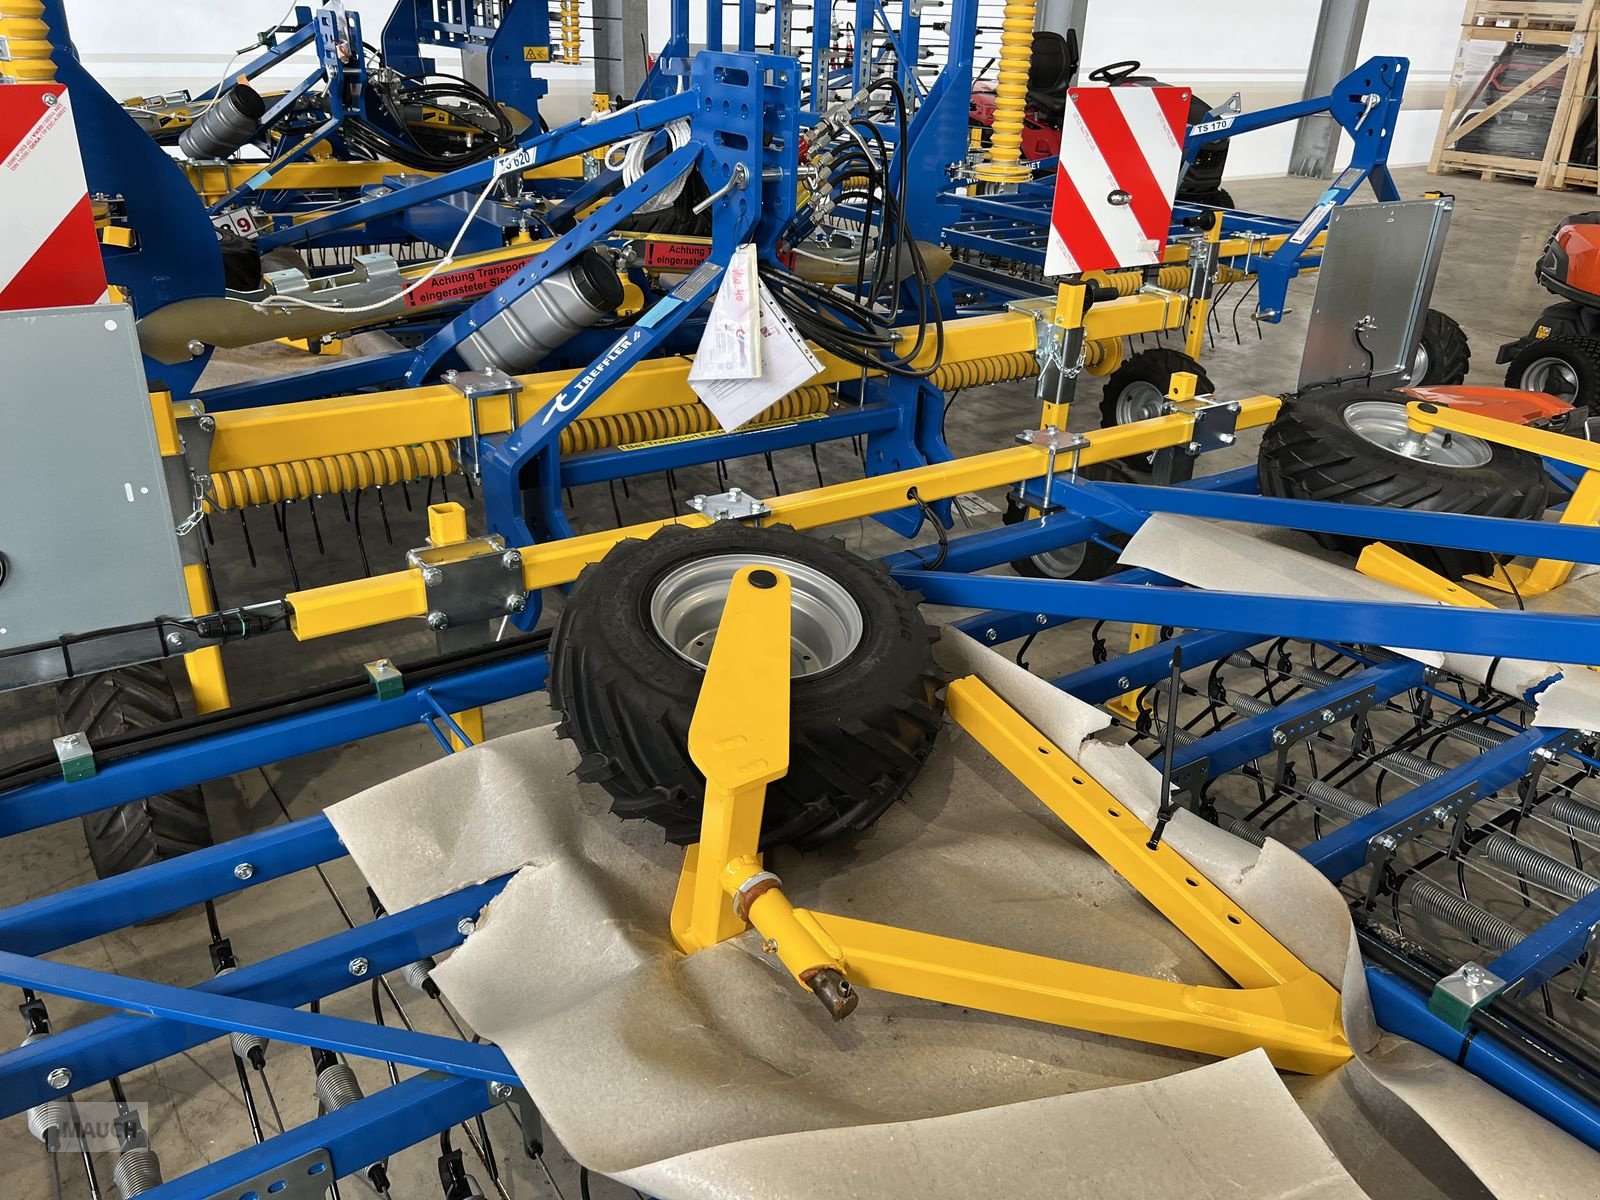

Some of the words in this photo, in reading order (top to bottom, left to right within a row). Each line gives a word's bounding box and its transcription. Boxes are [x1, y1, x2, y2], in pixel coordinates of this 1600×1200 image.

[1197, 124, 1208, 133] TS
[1211, 120, 1227, 130] 170
[514, 151, 530, 167] 620
[669, 245, 705, 257] Achtung
[431, 272, 475, 288] Achtung
[476, 260, 526, 278] Transport
[420, 281, 488, 303] eingerasteter
[574, 339, 632, 390] TREFFLER
